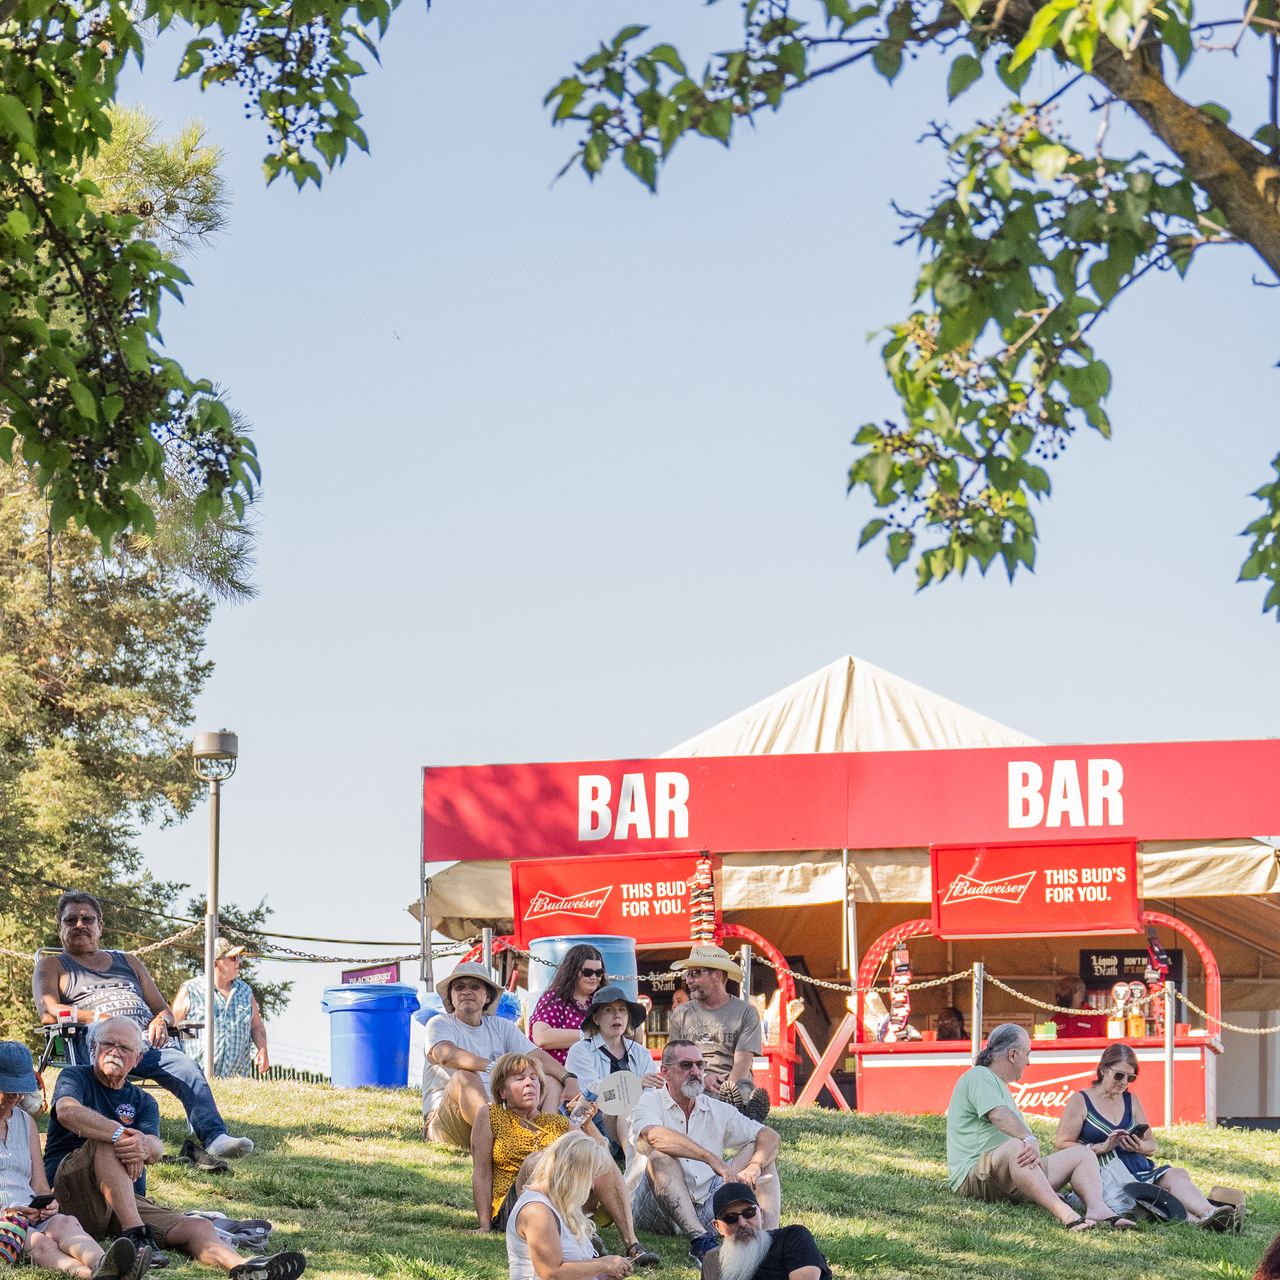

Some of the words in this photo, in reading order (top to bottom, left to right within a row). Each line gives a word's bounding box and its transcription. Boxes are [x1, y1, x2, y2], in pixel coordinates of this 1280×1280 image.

[1007, 758, 1124, 829] BAR
[577, 772, 690, 842] BAR
[1044, 869, 1078, 885] THIS
[1081, 866, 1126, 883] BUD'S
[621, 883, 652, 899] THIS
[950, 880, 1026, 897] Budweiser
[1045, 887, 1074, 904] FOR
[1078, 885, 1112, 902] YOU.
[529, 896, 604, 914] Budweiser
[622, 900, 650, 917] FOR
[654, 899, 686, 916] YOU.
[1091, 955, 1118, 968] Liquid
[1094, 966, 1118, 976] Death
[651, 981, 676, 991] Death
